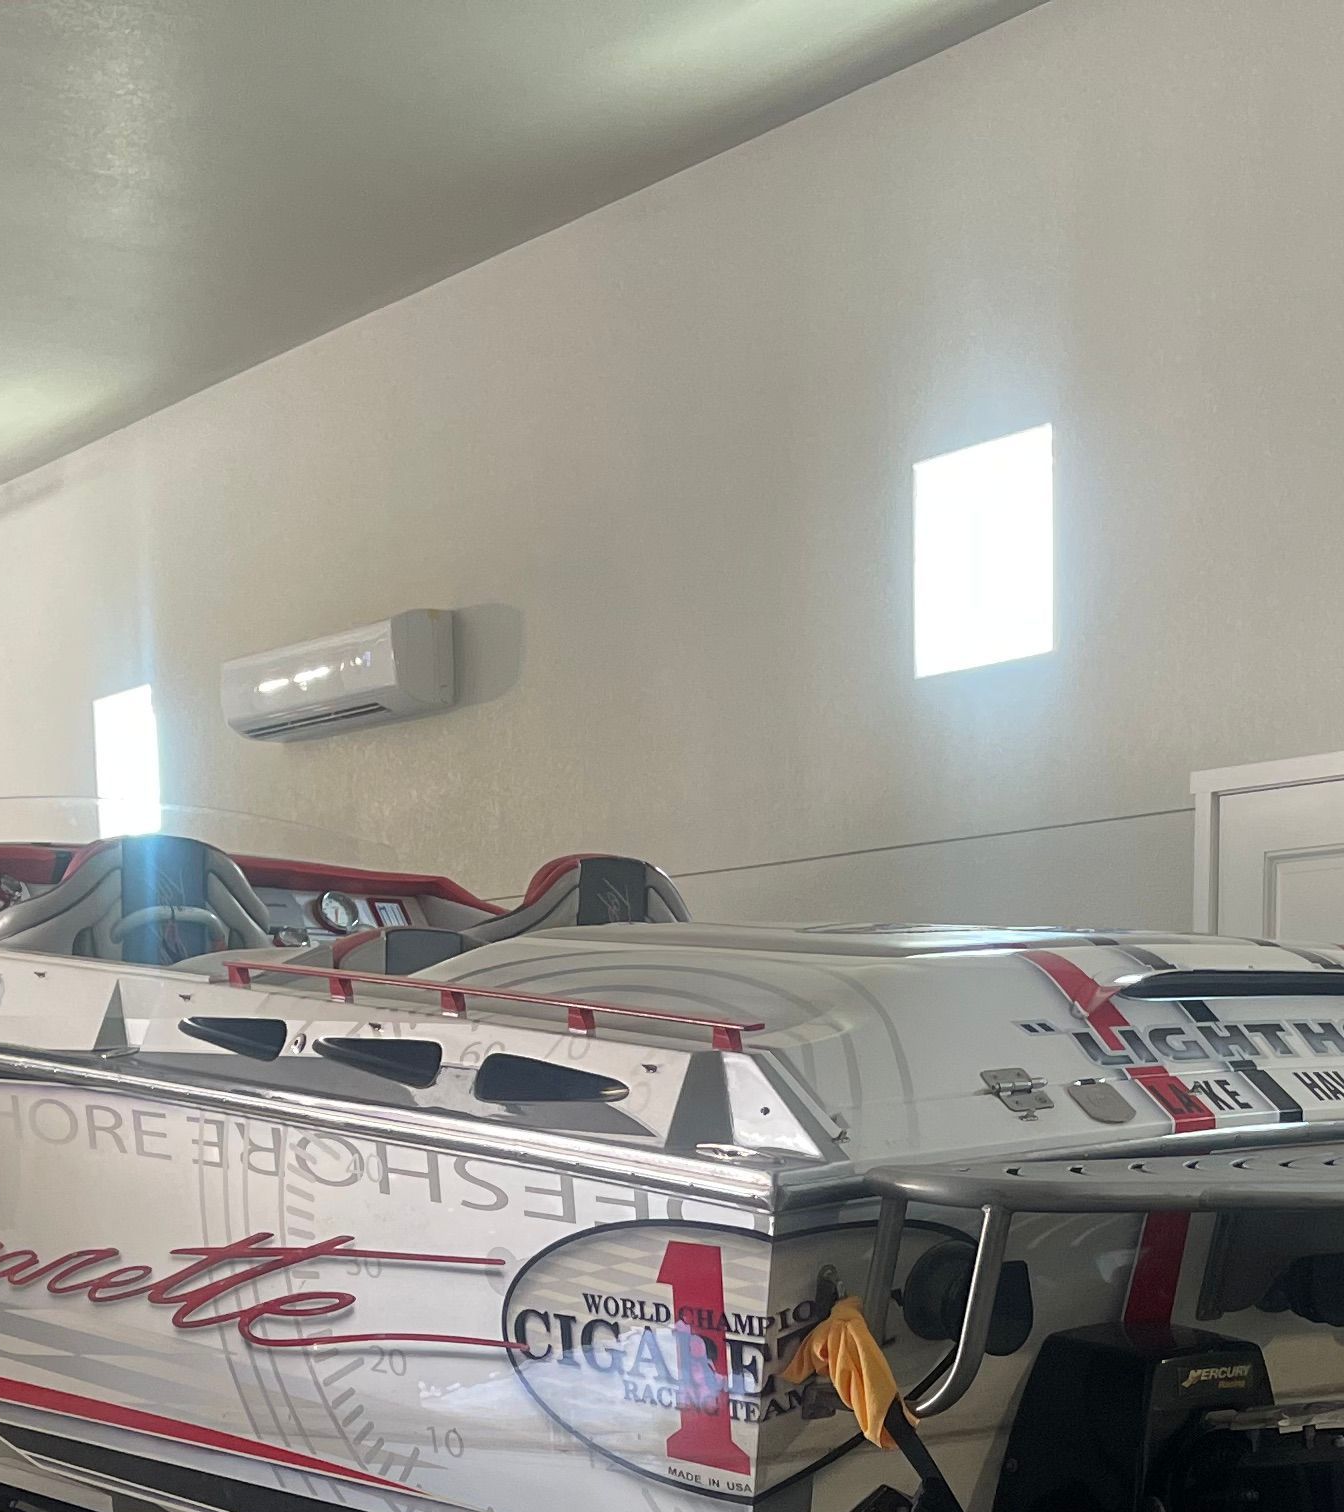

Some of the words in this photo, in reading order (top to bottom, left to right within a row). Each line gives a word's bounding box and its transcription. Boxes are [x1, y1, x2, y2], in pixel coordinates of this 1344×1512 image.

[1147, 1079, 1254, 1115] LAKE
[582, 1292, 672, 1324] WORLD
[677, 1299, 820, 1338] CHAMPIO
[369, 1344, 407, 1377] 20
[656, 1239, 752, 1476] 1
[1181, 1364, 1253, 1389] MERCURY
[622, 1379, 720, 1417] RACING
[426, 1426, 465, 1458] 10
[667, 1466, 702, 1485] MADE
[708, 1477, 721, 1489] IN
[726, 1481, 753, 1493] USA
